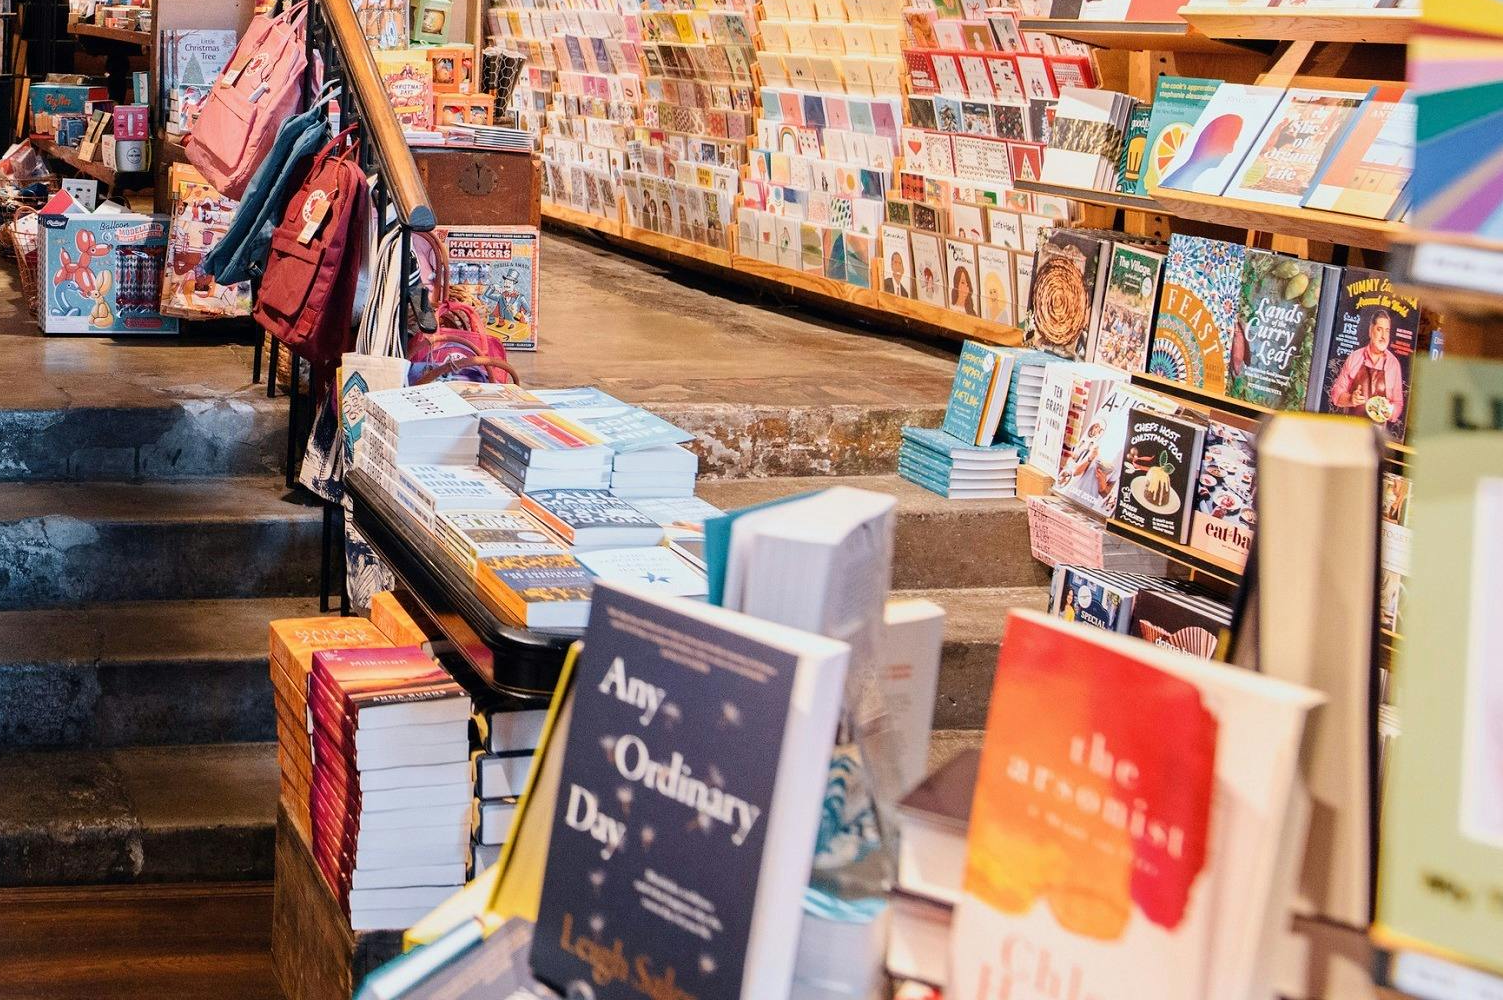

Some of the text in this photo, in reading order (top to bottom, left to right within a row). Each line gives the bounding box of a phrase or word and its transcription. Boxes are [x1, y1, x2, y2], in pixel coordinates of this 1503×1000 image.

[185, 44, 220, 52] Christmas
[1160, 91, 1184, 100] stephanie
[1171, 83, 1187, 91] cook's
[1267, 166, 1297, 181] Life
[100, 222, 130, 231] Balloon
[449, 240, 511, 249] MAGIC PARTY
[449, 249, 511, 258] CRACKERS
[1120, 256, 1152, 276] The Village
[1347, 279, 1379, 297] YUMMY
[1256, 297, 1303, 324] Lands
[1356, 295, 1409, 318] Around the World
[1166, 288, 1219, 357] FEAST
[1245, 316, 1295, 350] Curry
[1257, 341, 1297, 370] Leaf
[1054, 384, 1063, 397] TEN
[1046, 398, 1065, 418] GRAPES
[1131, 433, 1169, 449] CHRISTMAS
[1134, 422, 1181, 442] CHEFS HOST
[1080, 610, 1107, 628] SPECIAL
[351, 658, 408, 667] Milkman
[598, 656, 667, 726] Any
[1069, 731, 1140, 790] the
[614, 733, 761, 847] Ordinary
[1005, 754, 1186, 861] arsonist
[565, 784, 627, 860] Day
